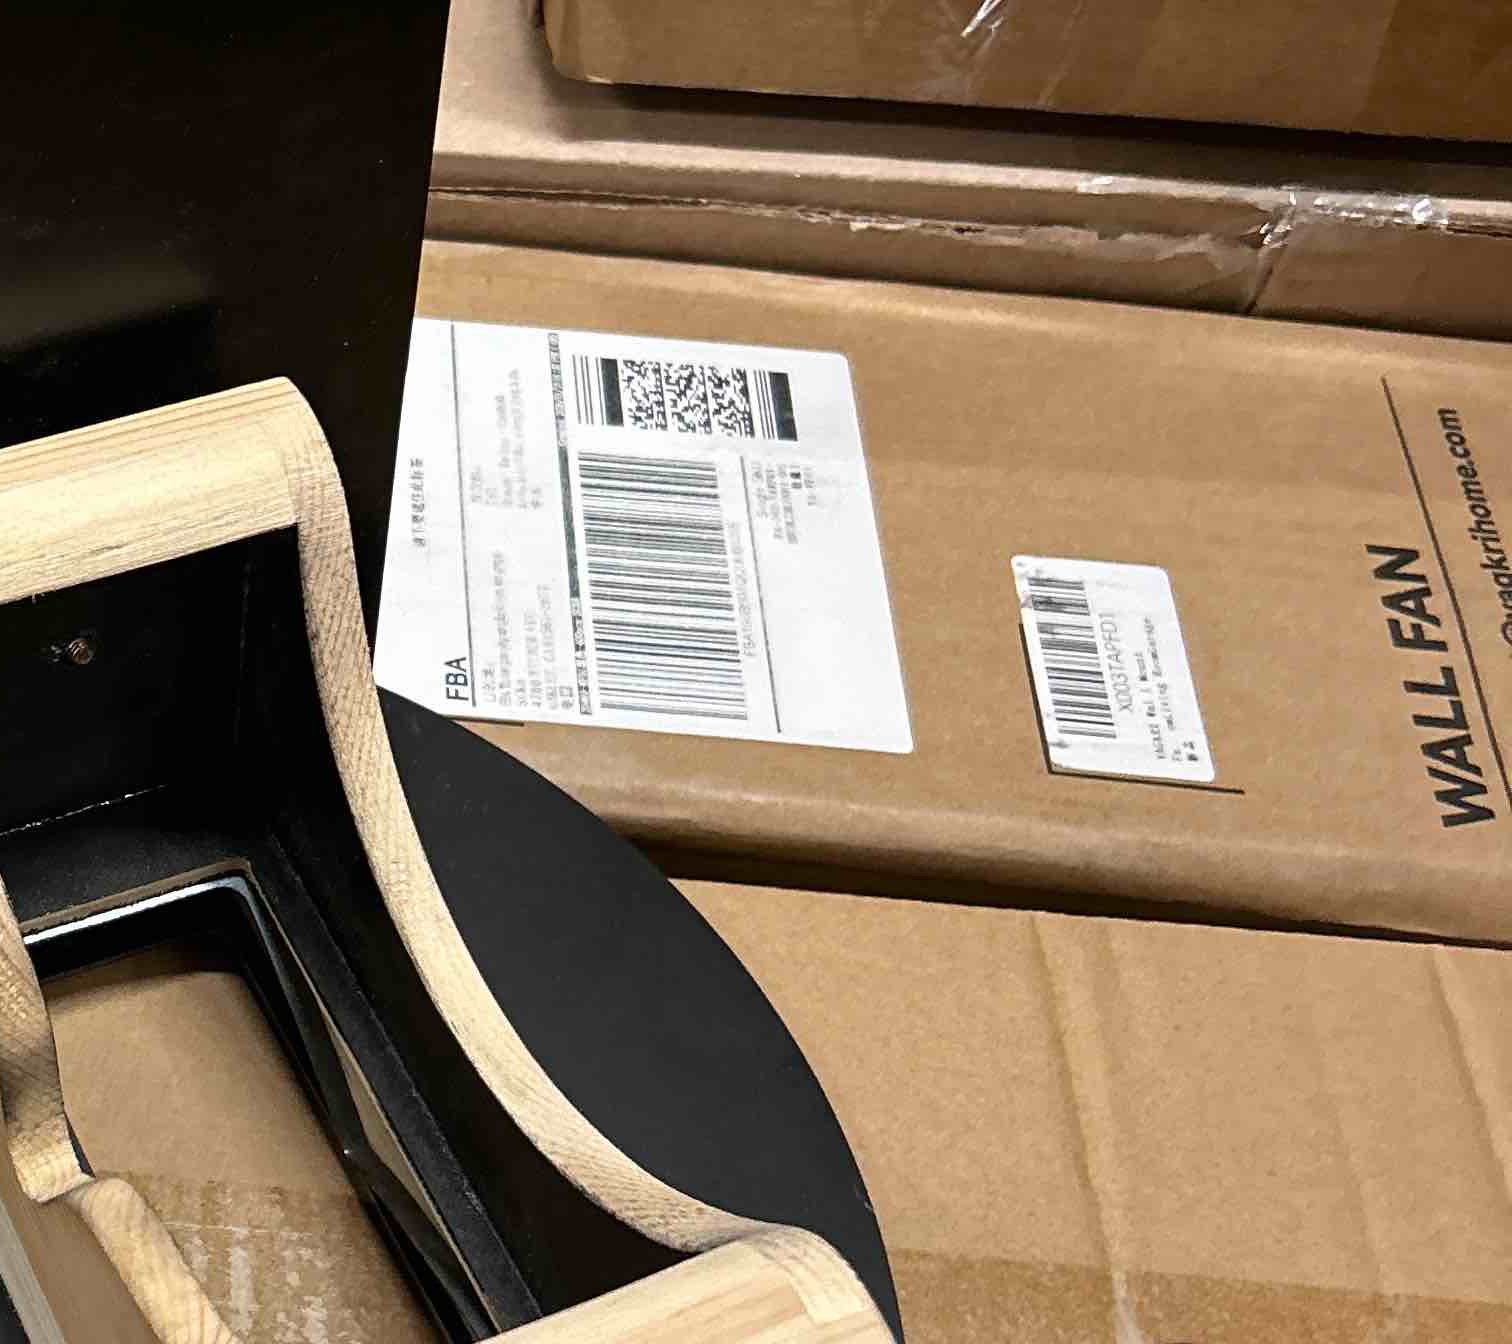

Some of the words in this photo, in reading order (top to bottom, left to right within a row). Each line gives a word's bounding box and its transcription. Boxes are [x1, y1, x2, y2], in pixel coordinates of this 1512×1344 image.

[1364, 543, 1449, 653] FAN
[443, 656, 471, 701] FBA
[1403, 665, 1496, 828] WALL
